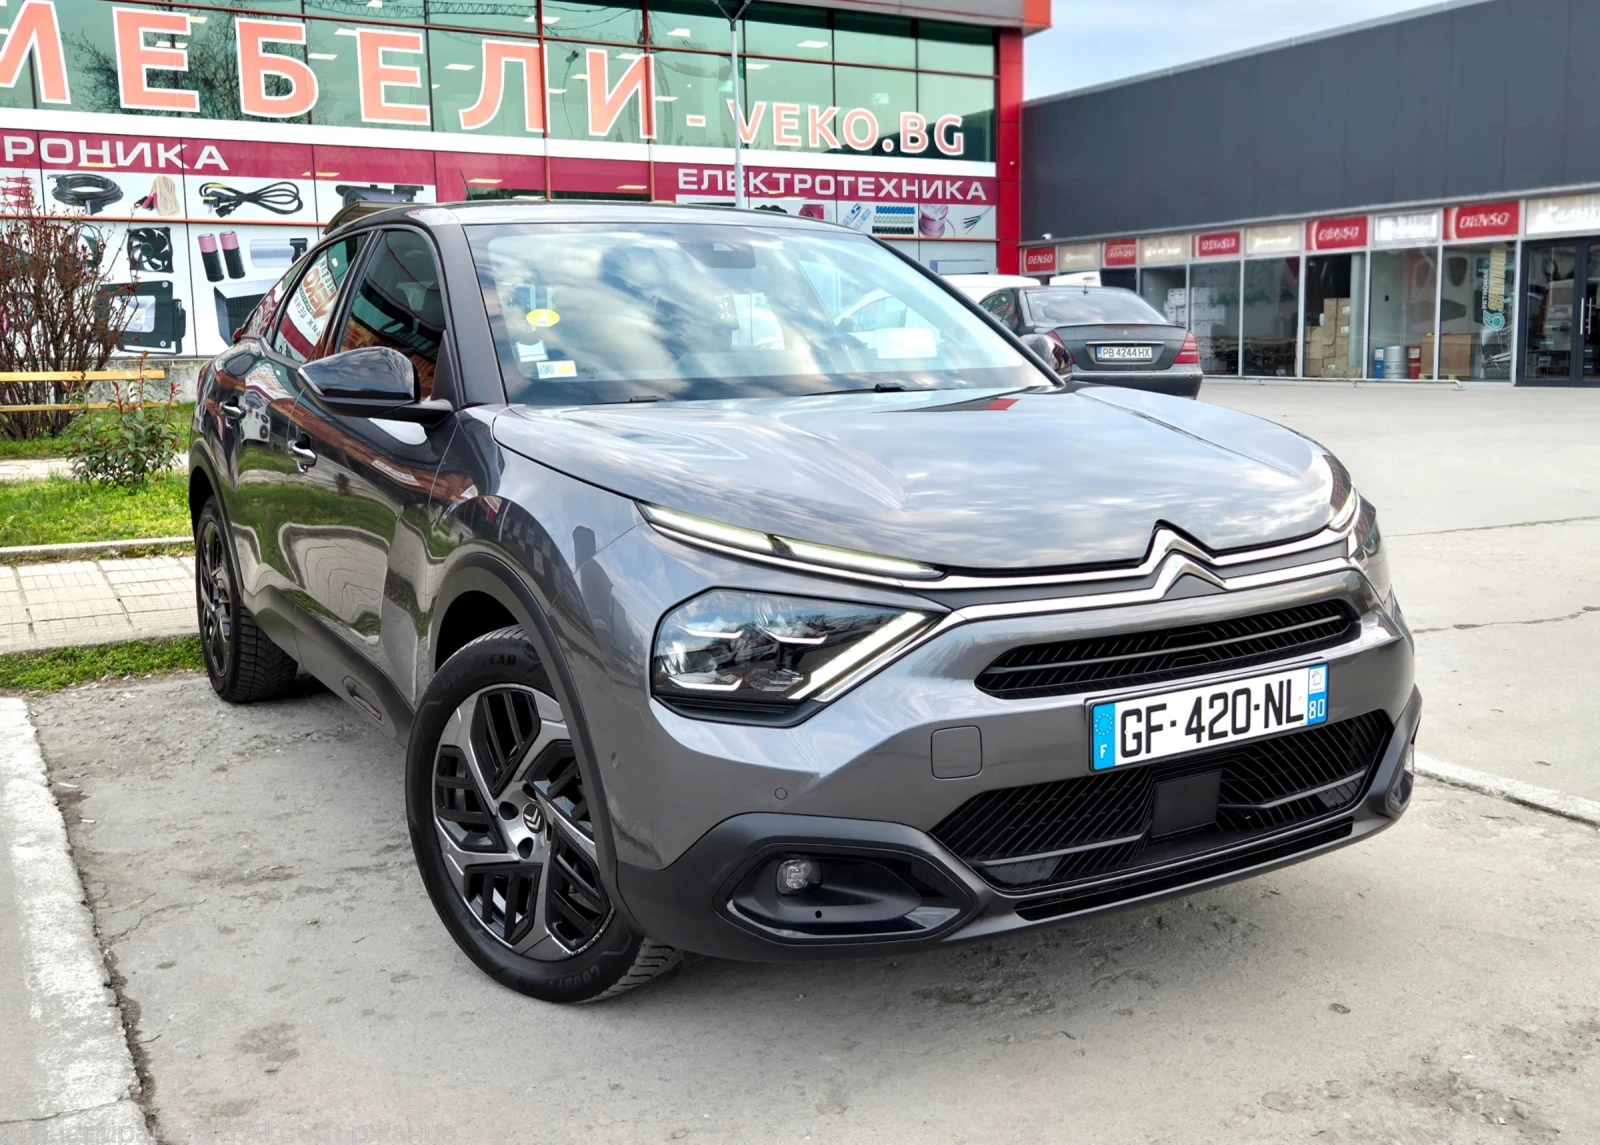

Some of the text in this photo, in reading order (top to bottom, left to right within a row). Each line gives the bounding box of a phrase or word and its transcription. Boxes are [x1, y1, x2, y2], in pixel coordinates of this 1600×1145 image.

[726, 99, 965, 156] VEKO.BG
[3, 135, 230, 171] РОНИКА
[677, 167, 987, 201] ЕЛЕКТРОТЕХНИКА
[1027, 253, 1053, 265] DENSO
[1116, 348, 1137, 358] 4244
[1138, 348, 1150, 357] HX
[1309, 698, 1325, 720] 80
[1099, 743, 1108, 759] F
